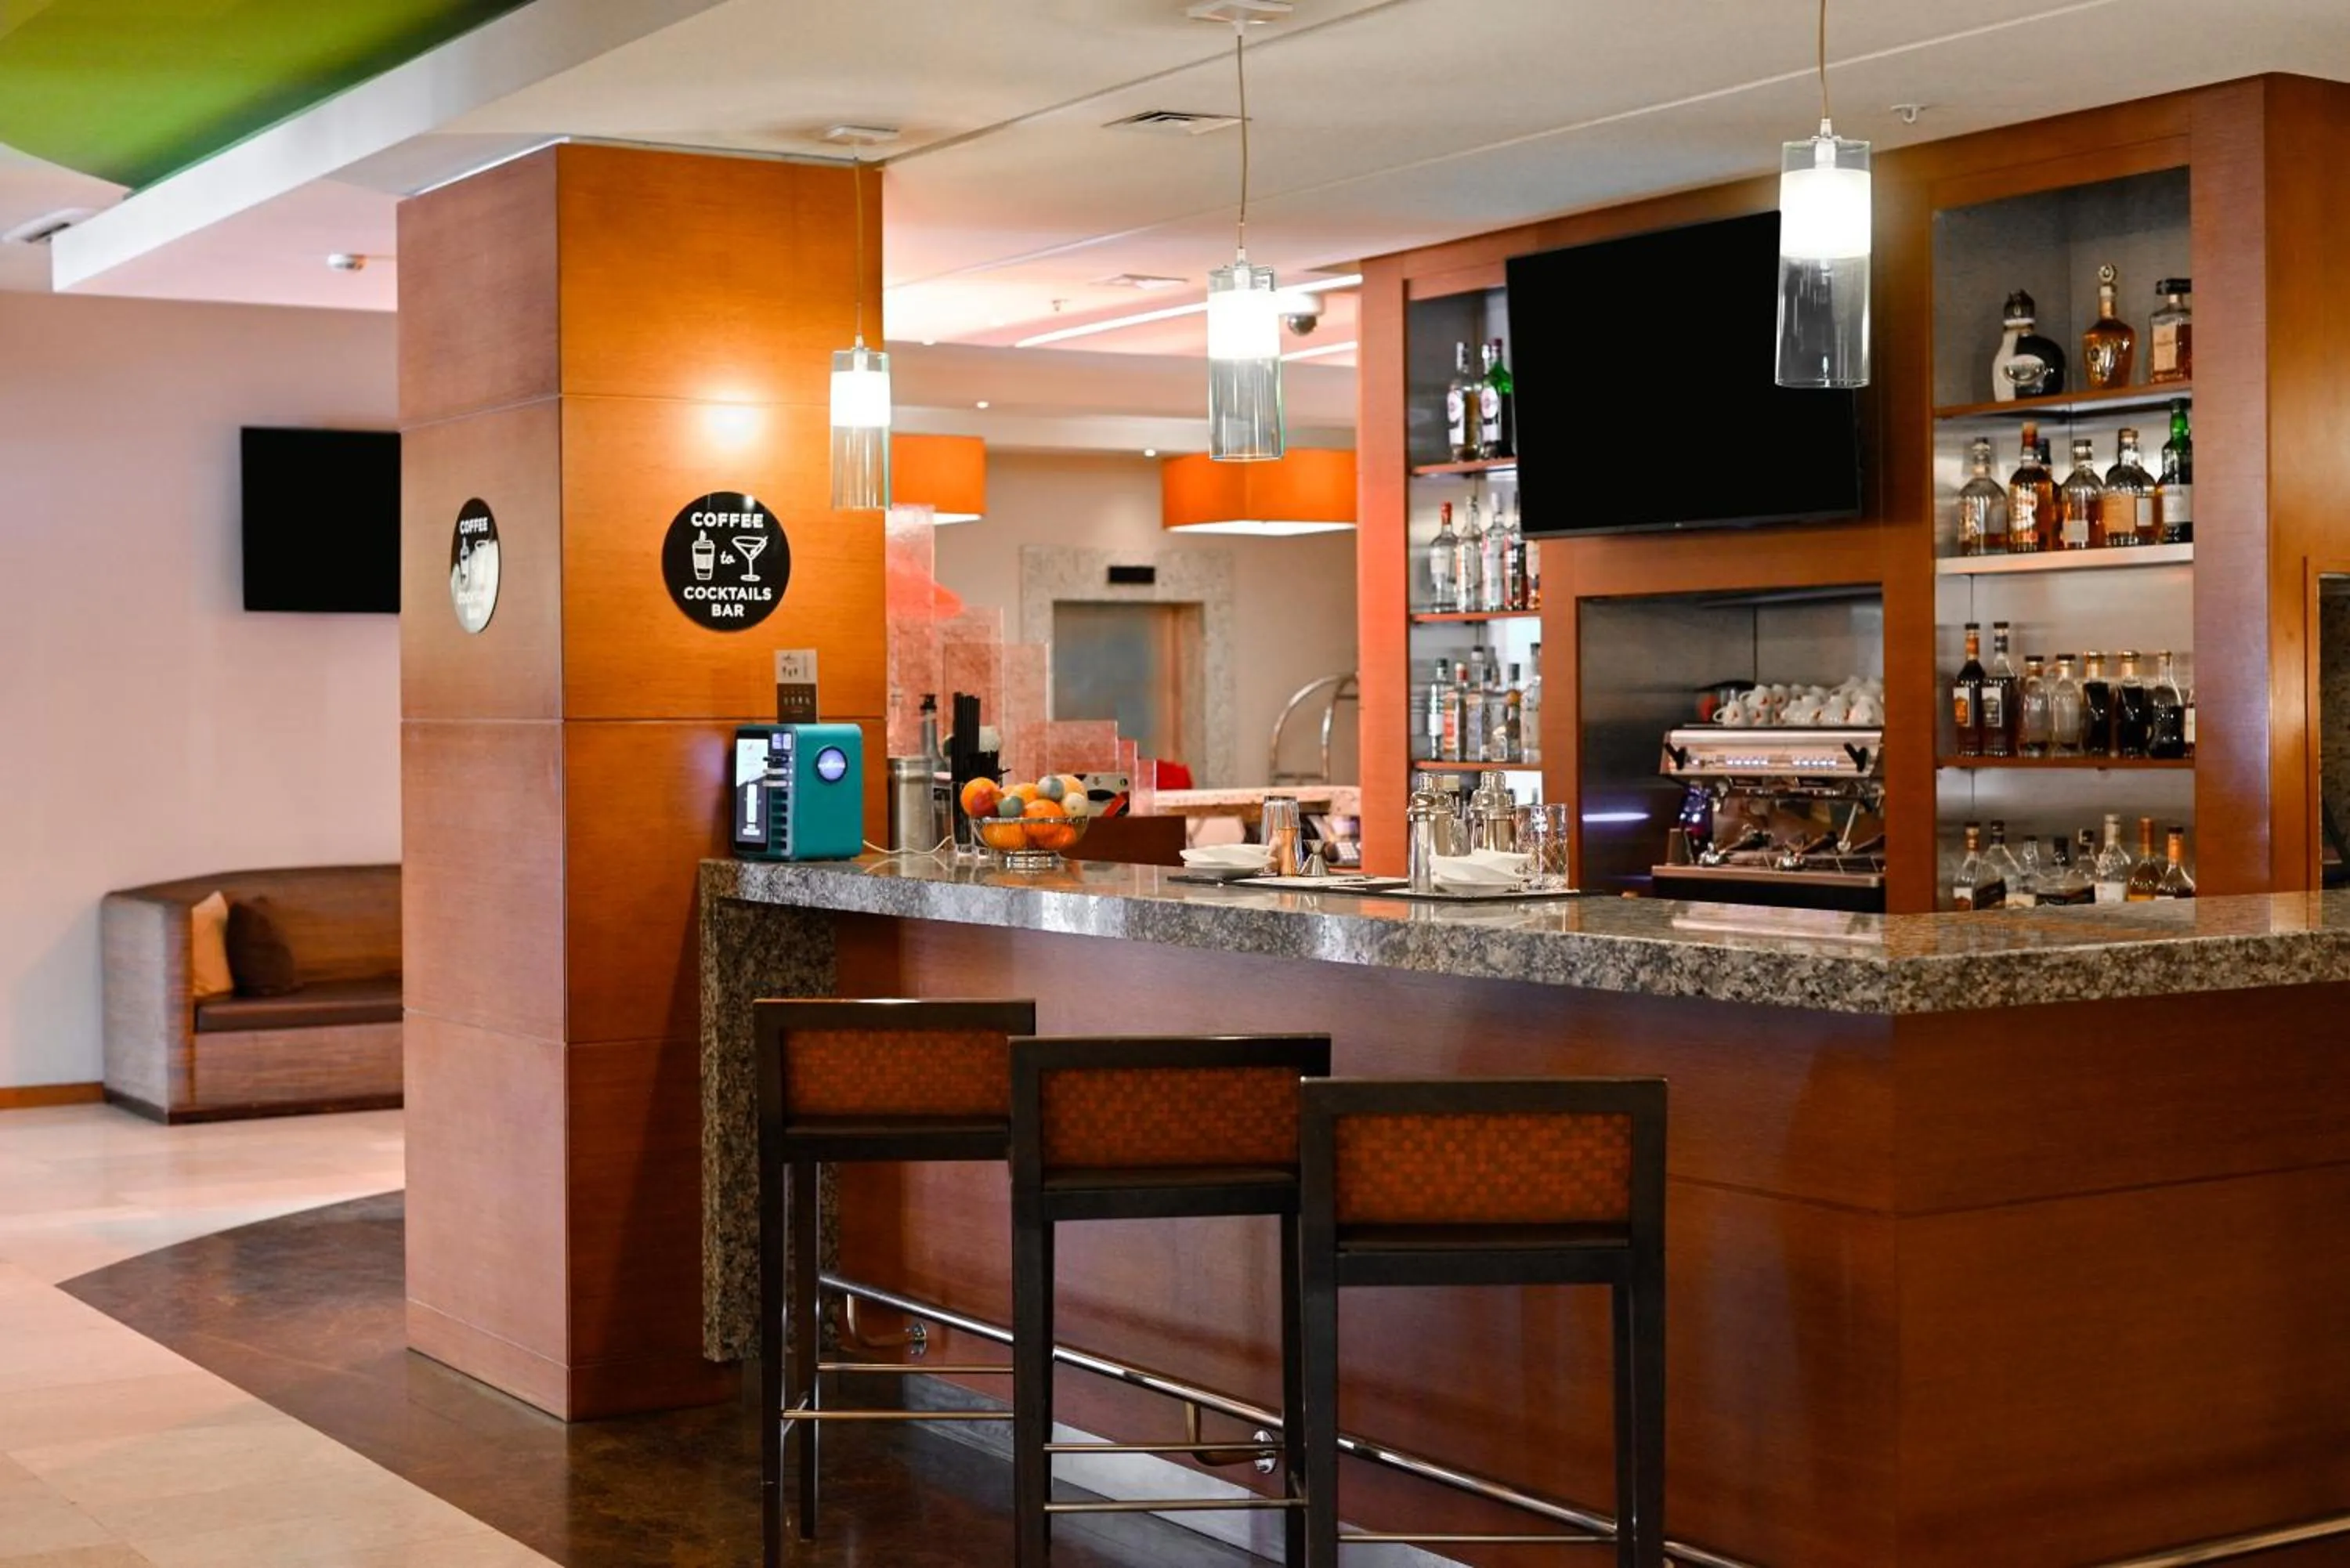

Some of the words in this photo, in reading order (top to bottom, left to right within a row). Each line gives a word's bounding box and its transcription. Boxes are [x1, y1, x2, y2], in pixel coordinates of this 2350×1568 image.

[459, 517, 488, 534] COFFEE
[690, 512, 764, 528] COFFEE
[720, 551, 736, 564] to
[683, 587, 772, 601] COCKTAILS
[711, 604, 744, 616] BAR
